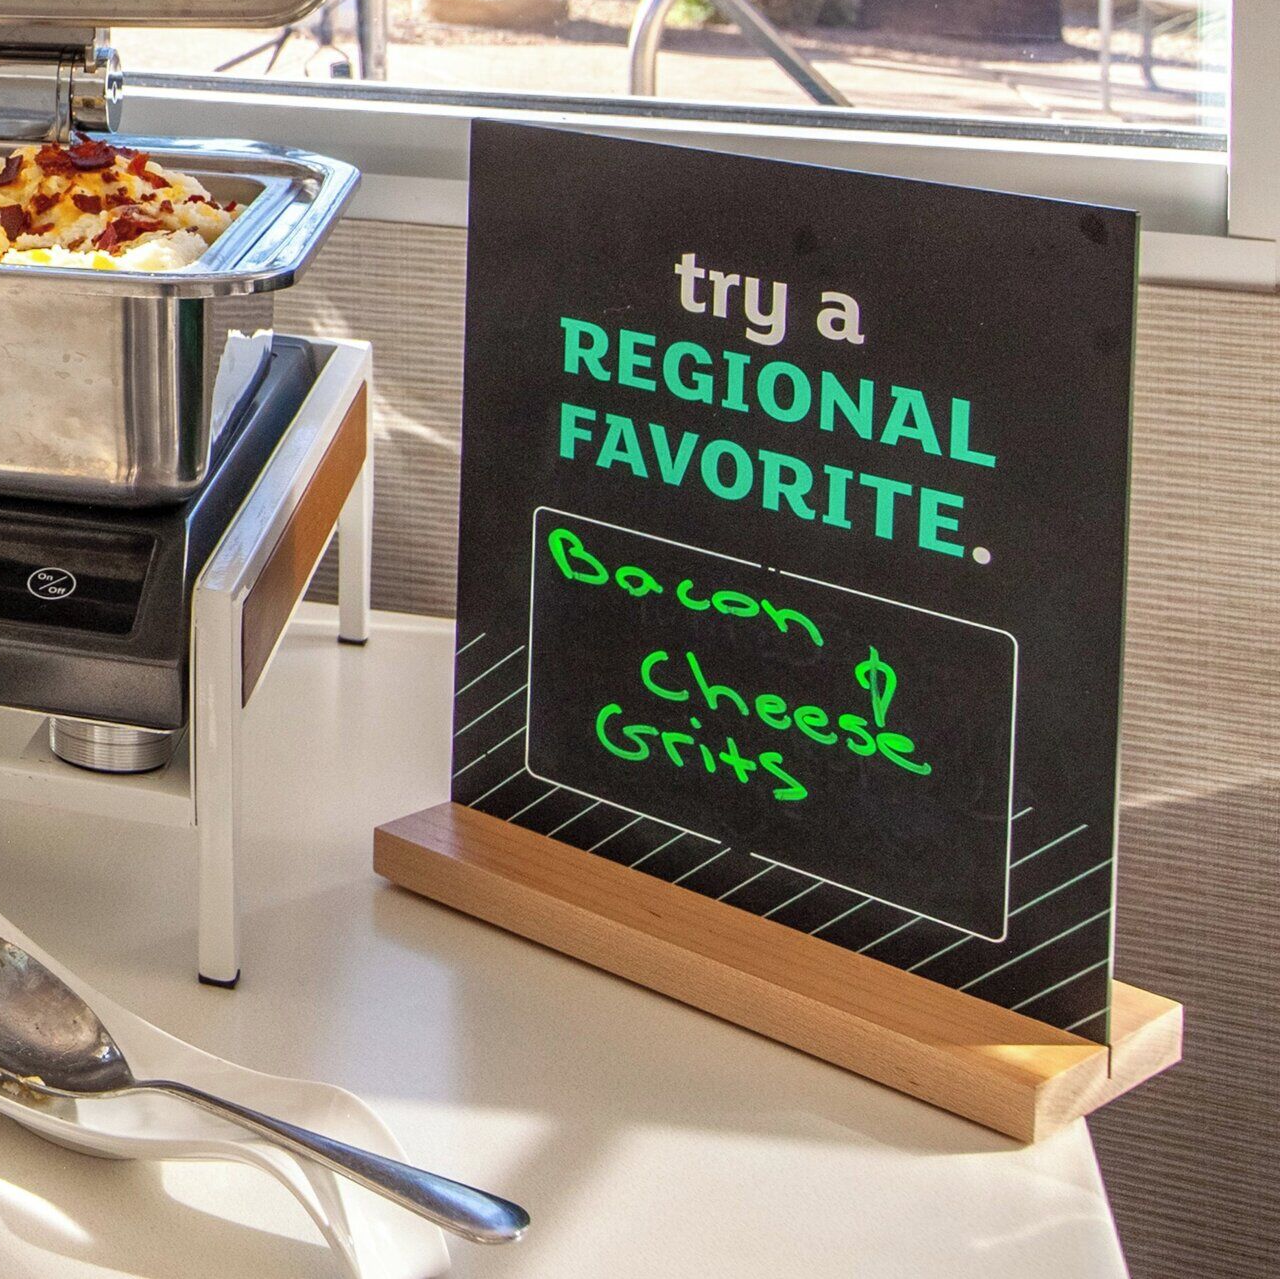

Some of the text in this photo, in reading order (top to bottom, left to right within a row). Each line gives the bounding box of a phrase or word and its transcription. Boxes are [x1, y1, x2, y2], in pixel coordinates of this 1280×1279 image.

[674, 253, 865, 346] try a
[559, 317, 996, 468] REGIONAL
[558, 403, 991, 565] FAVORITE.
[37, 572, 54, 582] On
[48, 586, 66, 596] Off
[548, 529, 824, 647] Bacon
[595, 703, 808, 801] Grits
[641, 651, 932, 775] Cheese
